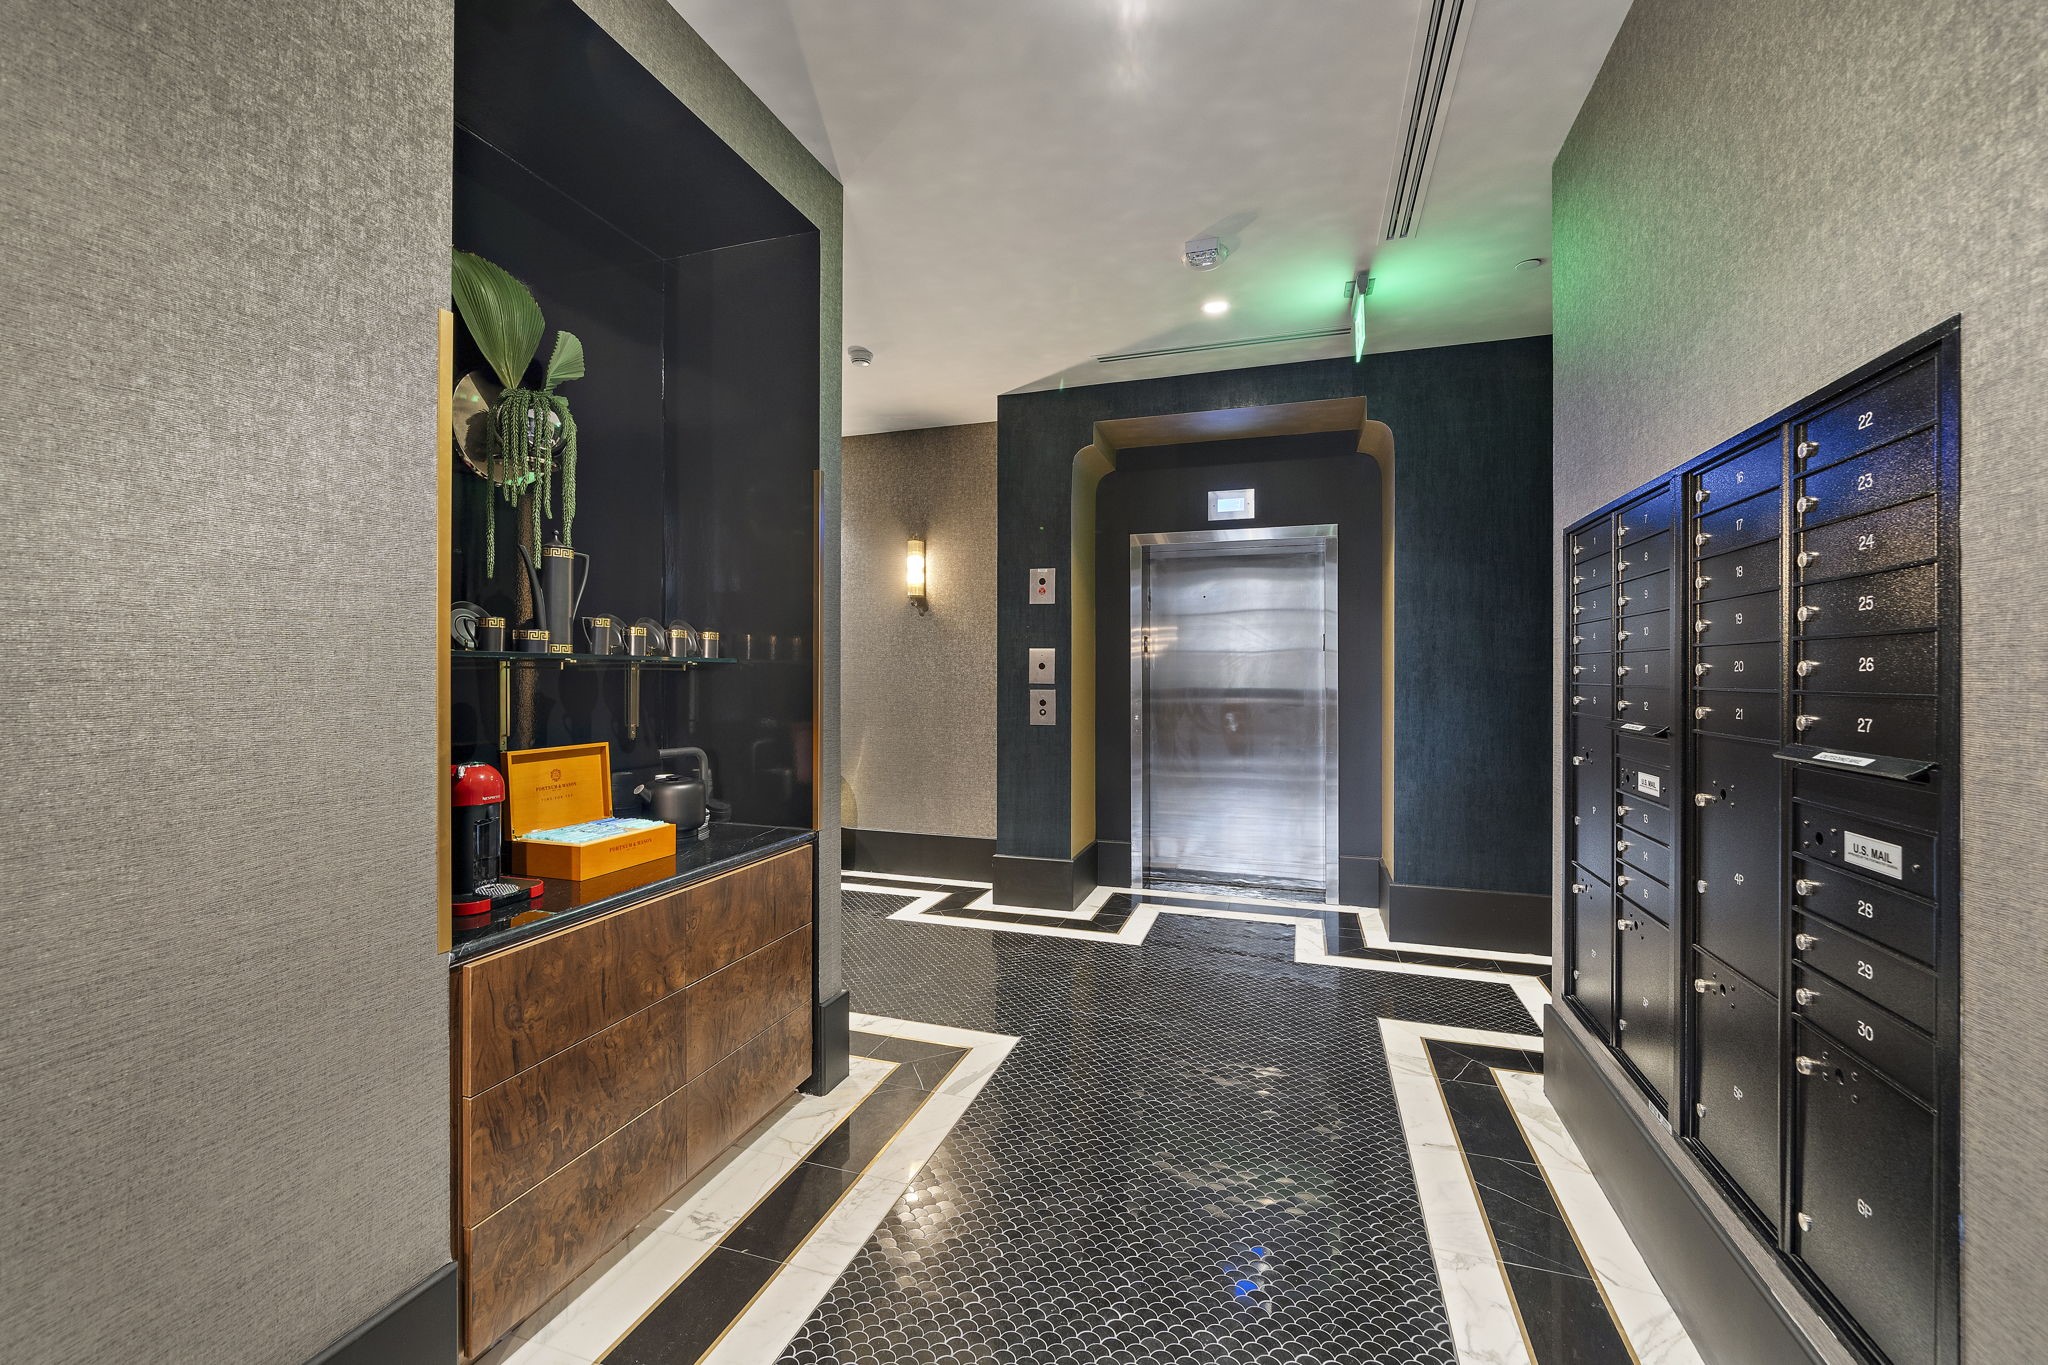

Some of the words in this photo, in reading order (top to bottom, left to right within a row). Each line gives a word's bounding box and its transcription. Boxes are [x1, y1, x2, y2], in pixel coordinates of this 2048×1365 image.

[1858, 411, 1874, 431] 22
[1735, 470, 1744, 484] 16
[1857, 472, 1874, 491] 23
[1643, 513, 1649, 524] 7
[1735, 518, 1744, 531] 17
[1857, 533, 1876, 551] 24
[1644, 551, 1649, 561] 8
[1735, 565, 1744, 578] 18
[1644, 589, 1649, 599] 9
[1858, 595, 1876, 612] 25
[1735, 612, 1743, 625] 19
[1643, 626, 1649, 636] 10
[1733, 660, 1744, 673] 20
[1858, 656, 1875, 672] 26
[1643, 701, 1649, 711] 12
[1735, 707, 1743, 720] 21
[1857, 717, 1873, 733] 27
[1643, 813, 1649, 824] 13
[1642, 851, 1649, 862] 14
[1853, 842, 1869, 856] U.S.
[1870, 848, 1892, 864] MAIL
[1734, 872, 1744, 886] 4P
[1857, 899, 1873, 919] 28
[1857, 960, 1874, 980] 29
[1857, 1020, 1874, 1042] 30
[1857, 1198, 1873, 1218] 6P
